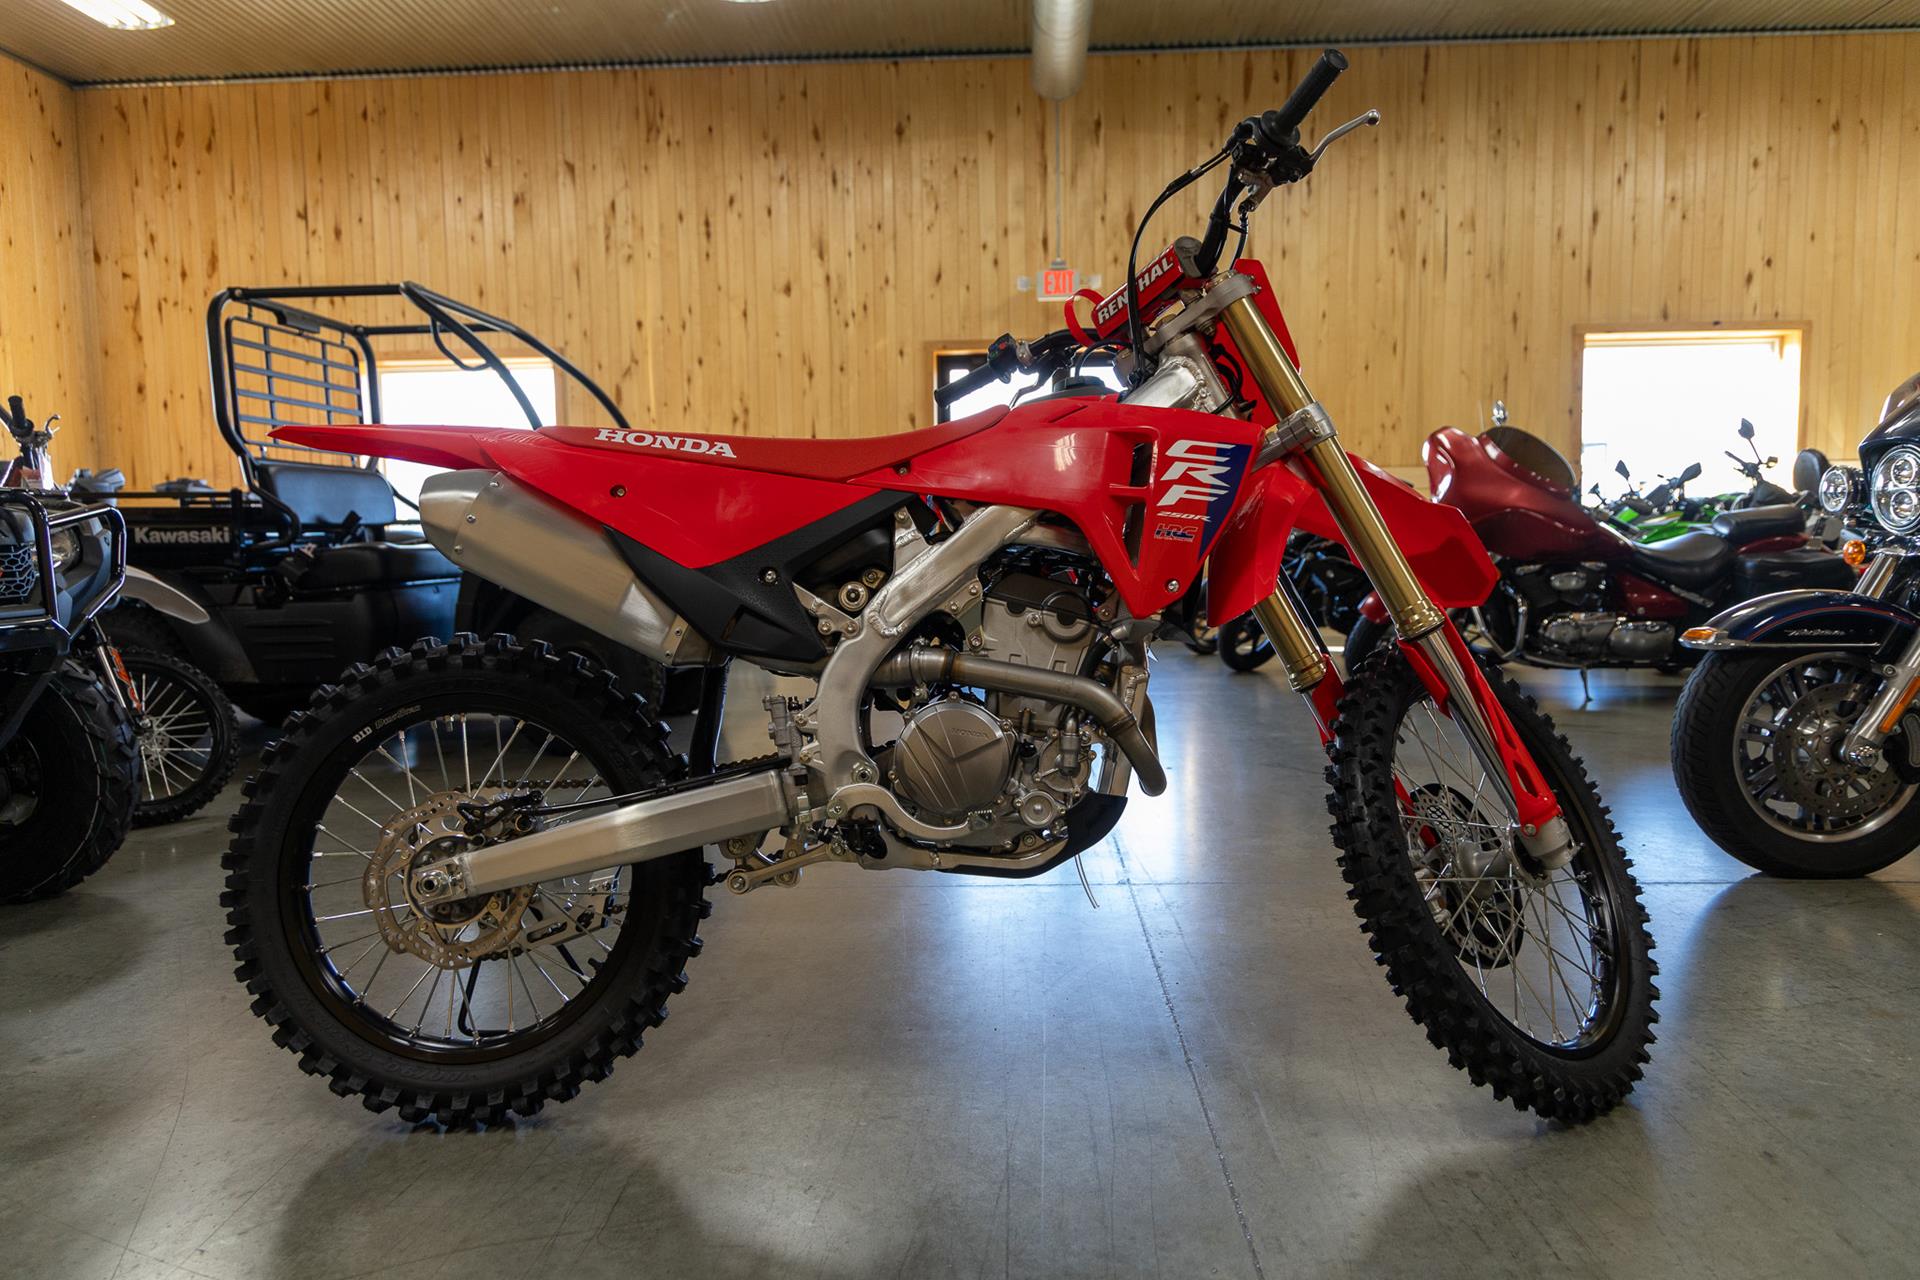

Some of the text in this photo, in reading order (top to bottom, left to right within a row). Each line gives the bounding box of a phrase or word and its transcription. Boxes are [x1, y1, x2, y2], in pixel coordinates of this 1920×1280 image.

[1043, 270, 1074, 295] EXIT
[1098, 257, 1174, 325] RENHAL
[595, 429, 737, 458] HONDA
[1156, 439, 1236, 507] CRF
[1156, 511, 1211, 522] 250R
[134, 526, 230, 544] Kawasaki
[1154, 523, 1198, 540] HRC
